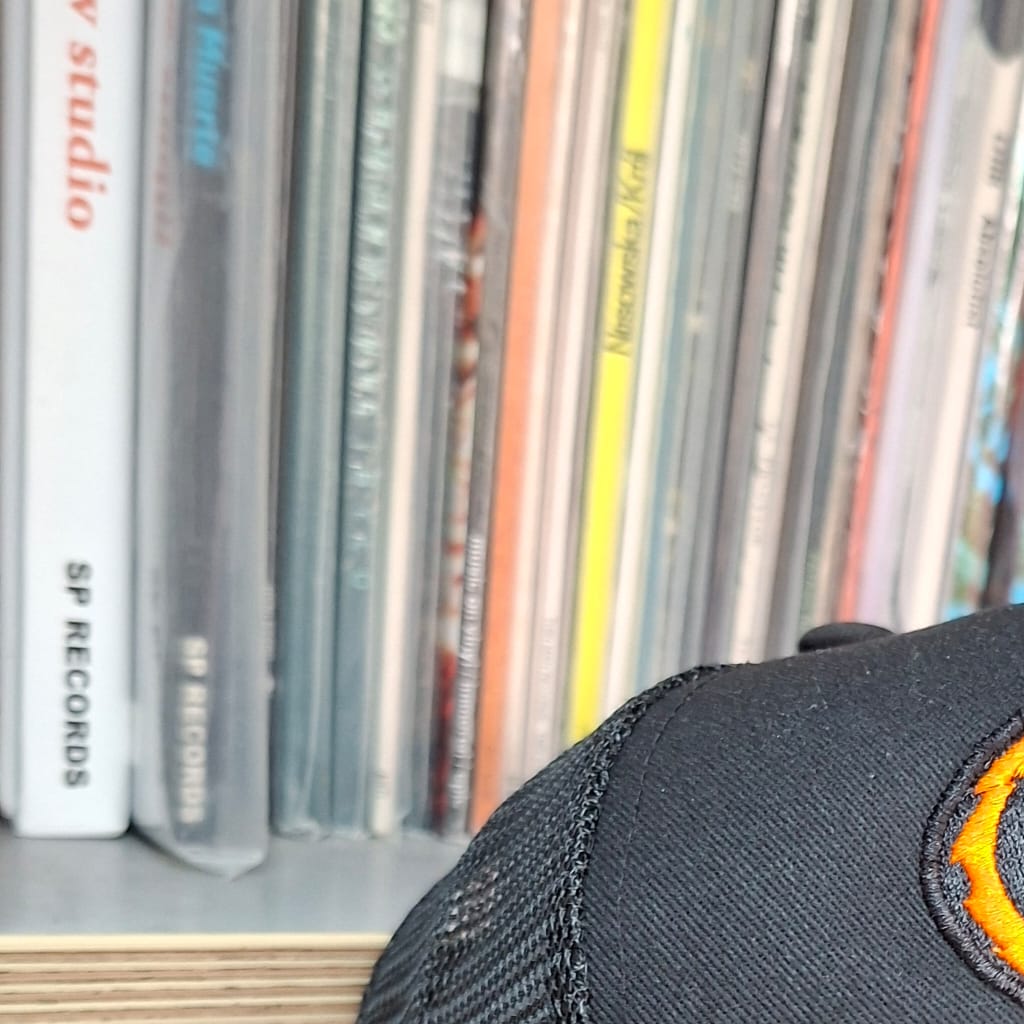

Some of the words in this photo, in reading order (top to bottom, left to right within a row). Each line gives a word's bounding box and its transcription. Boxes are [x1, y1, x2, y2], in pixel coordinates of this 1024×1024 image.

[67, 40, 111, 232] studio
[65, 560, 92, 607] SP
[64, 619, 91, 789] RECORDS
[180, 635, 208, 677] SP
[179, 682, 208, 824] RECORDS
